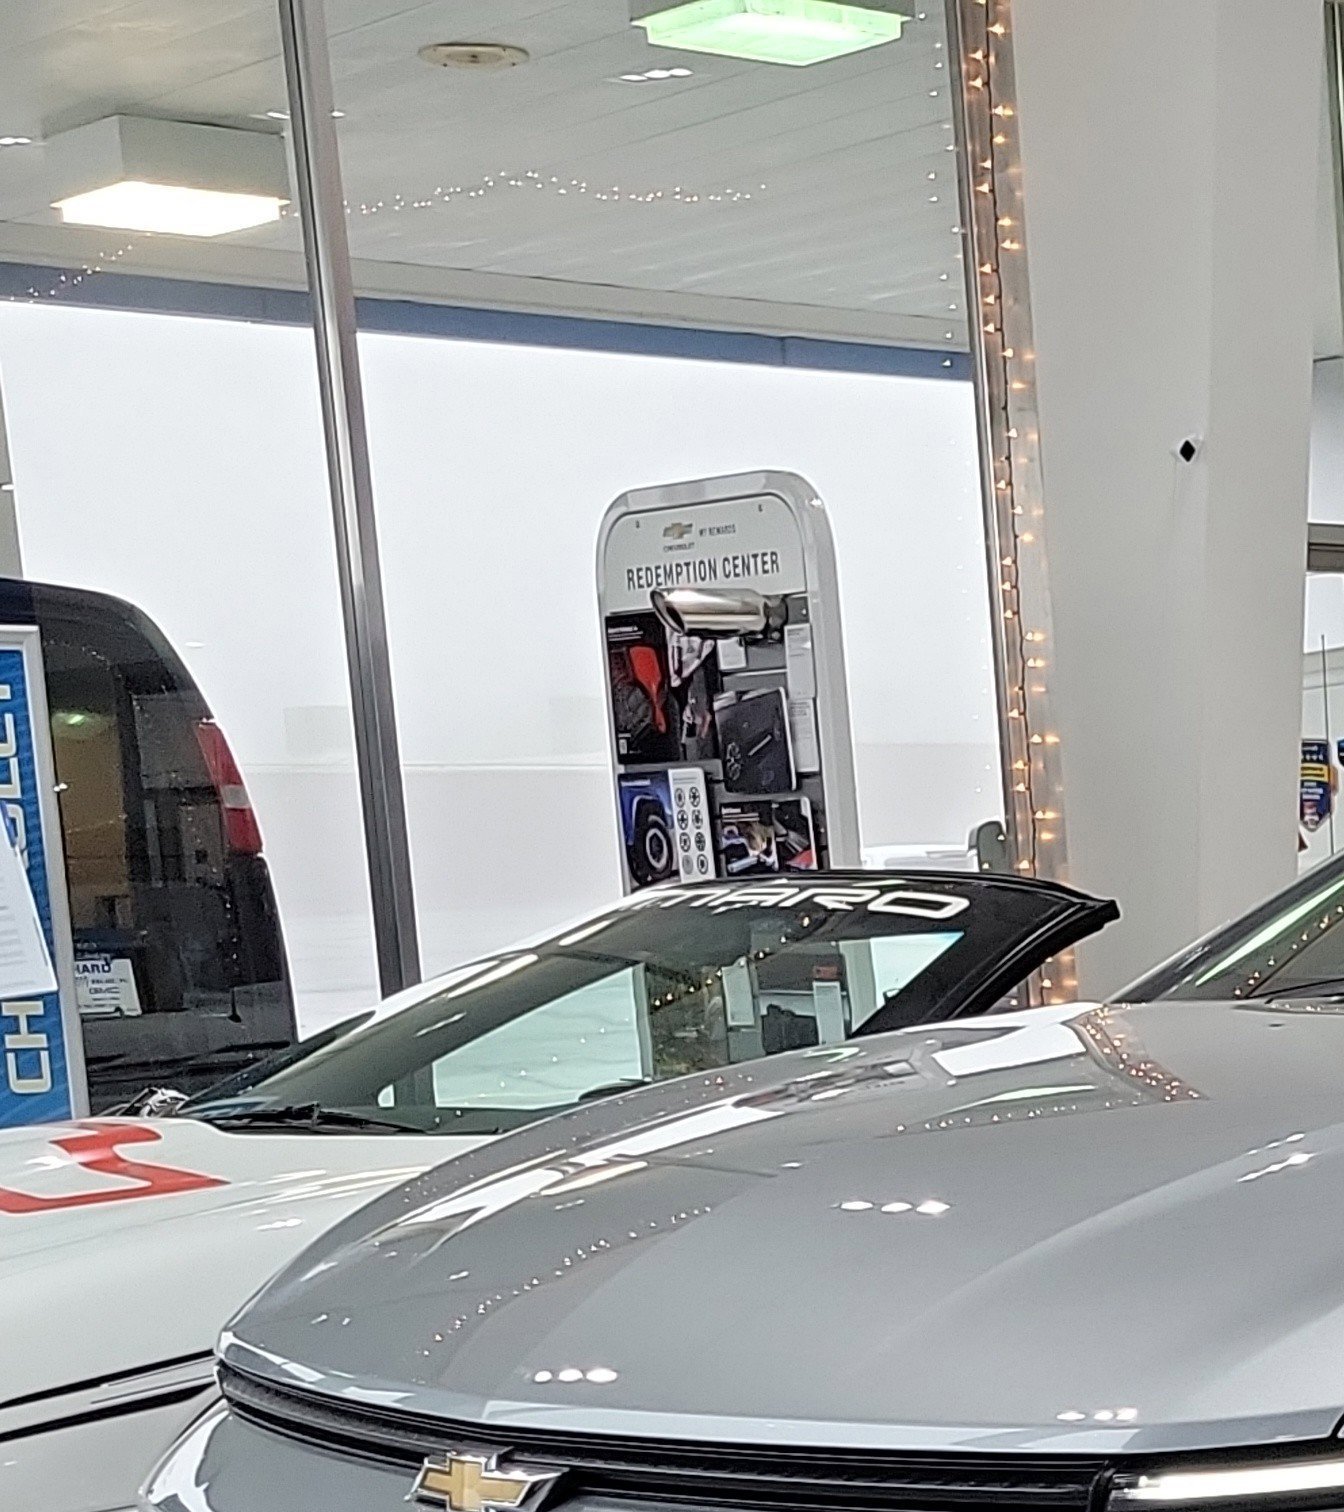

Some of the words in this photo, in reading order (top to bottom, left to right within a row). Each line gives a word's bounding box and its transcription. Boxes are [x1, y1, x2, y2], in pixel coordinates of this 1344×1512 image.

[626, 556, 718, 591] REDEMPTION
[722, 551, 780, 578] CENTER
[632, 887, 970, 920] MARO
